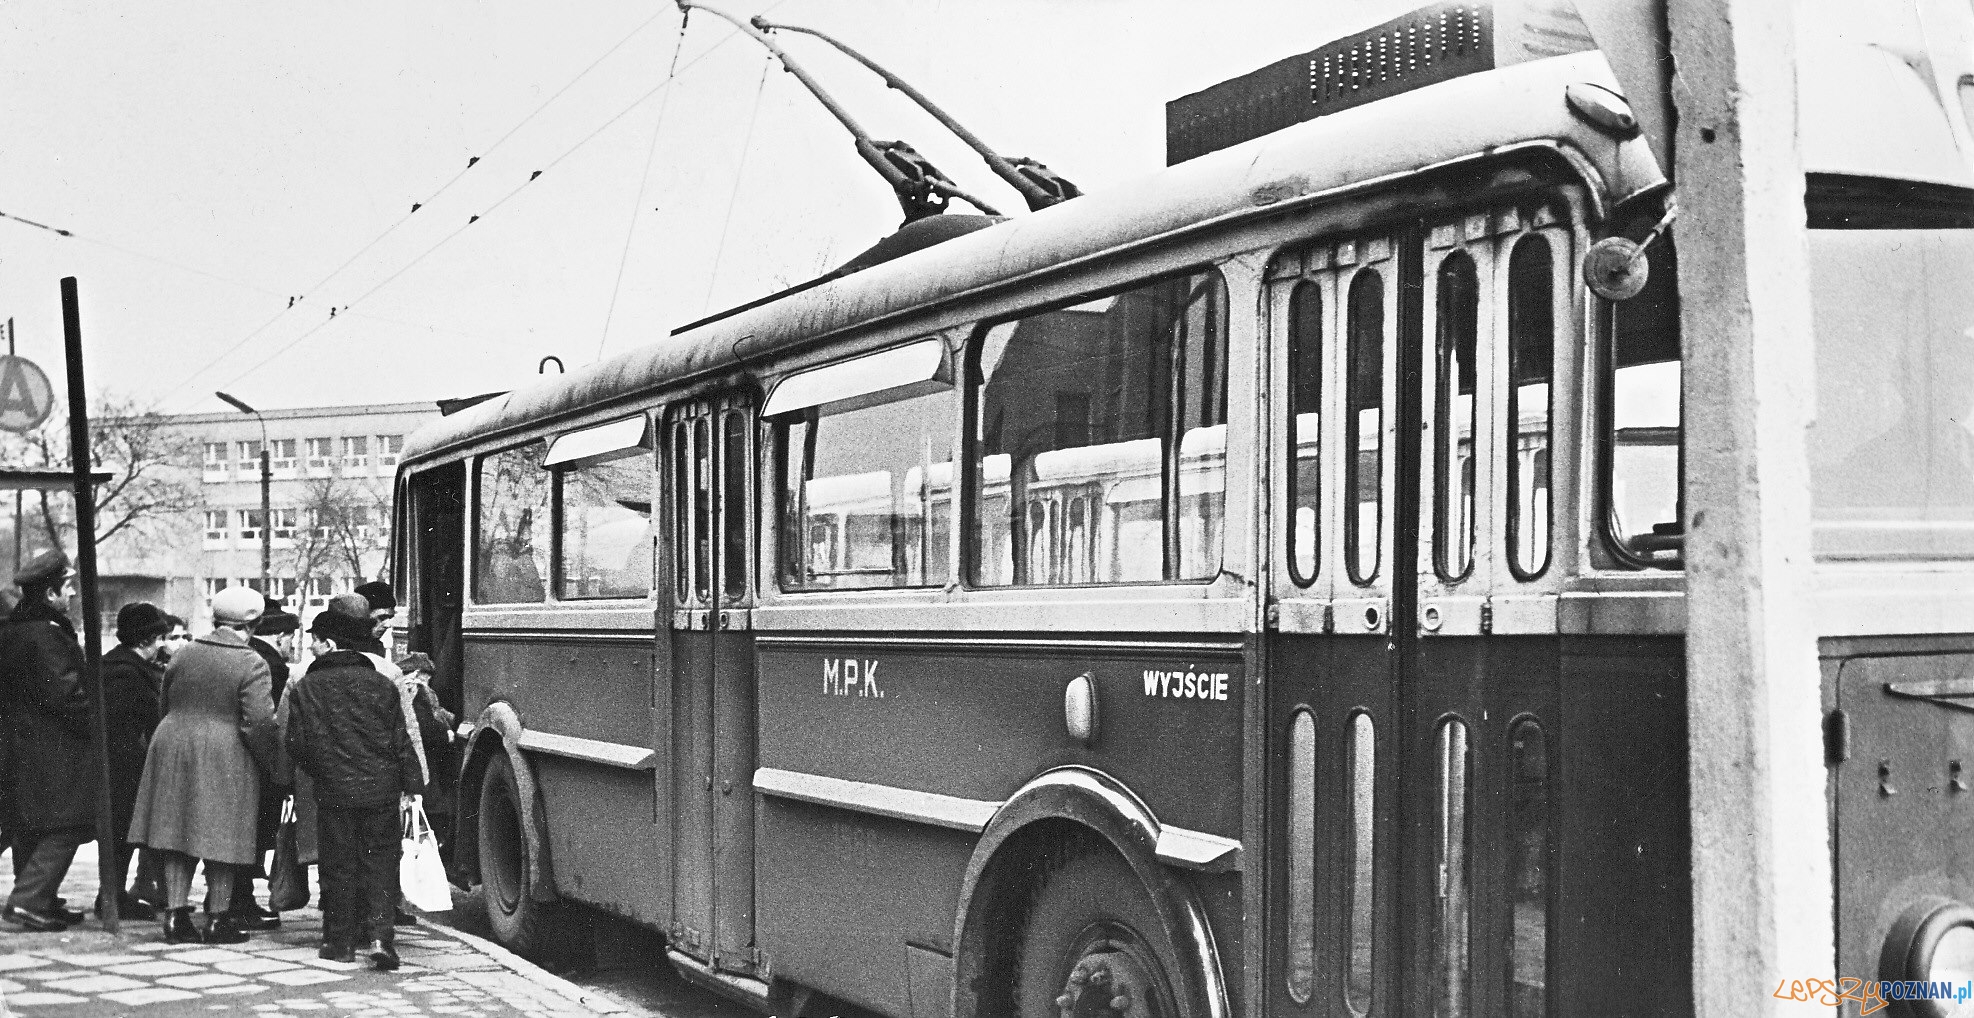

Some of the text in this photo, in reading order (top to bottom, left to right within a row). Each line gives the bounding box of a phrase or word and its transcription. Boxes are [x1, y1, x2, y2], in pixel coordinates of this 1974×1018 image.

[0, 356, 38, 418] A
[823, 658, 885, 698] M.P.K.
[1143, 663, 1229, 701] WYJŚCIE
